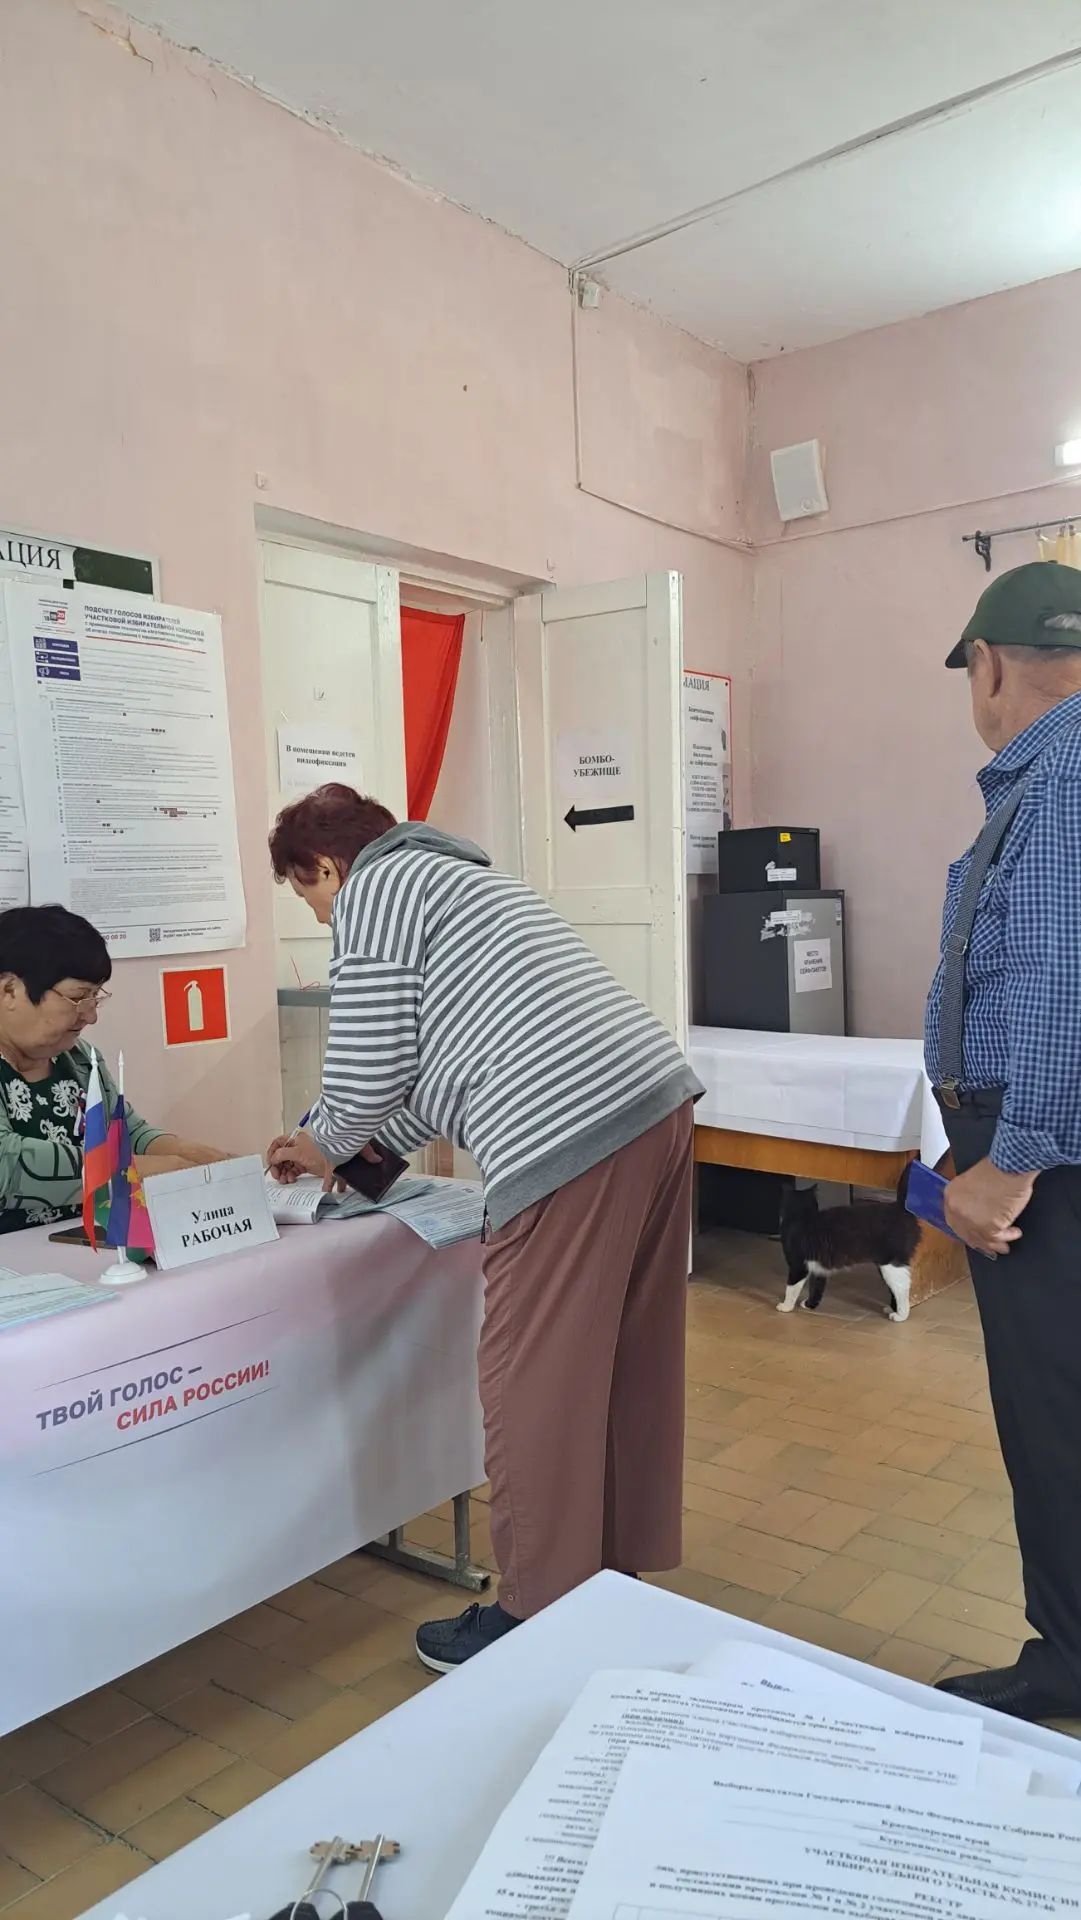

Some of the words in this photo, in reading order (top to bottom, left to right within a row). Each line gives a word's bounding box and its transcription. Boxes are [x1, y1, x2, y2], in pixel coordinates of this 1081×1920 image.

[84, 605, 113, 615] ПОДСЧЕТ
[114, 609, 141, 619] ГОЛОСОВ
[85, 614, 126, 624] УЧАСТКОВОЙ
[579, 754, 616, 765] БОМБО-
[573, 767, 622, 777] УБЕЖИЩЕ
[190, 1204, 235, 1225] Улица
[181, 1218, 253, 1248] РАБОЧАЯ
[36, 1389, 103, 1430] ТВОЙ
[109, 1366, 183, 1406] ГОЛОС
[117, 1395, 178, 1430] СИЛА
[183, 1359, 270, 1407] РОССИИ!
[914, 1892, 964, 1908] РЕЕСТР
